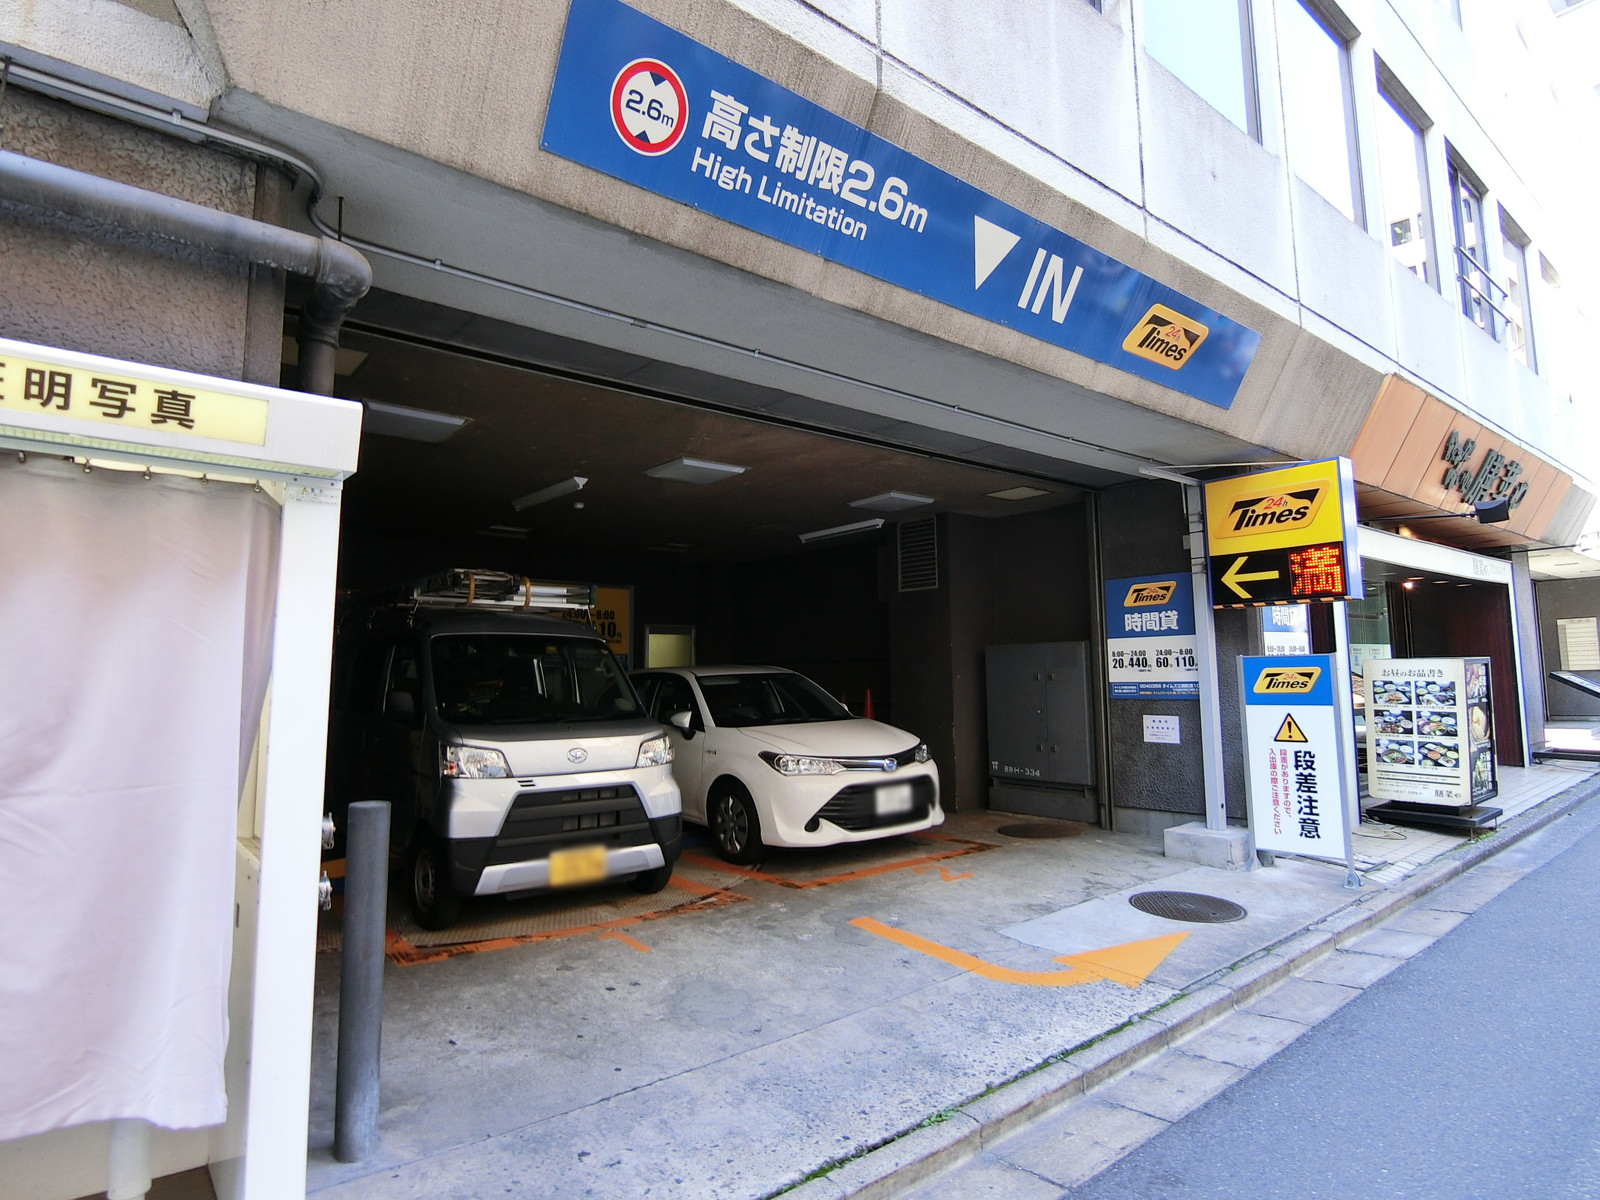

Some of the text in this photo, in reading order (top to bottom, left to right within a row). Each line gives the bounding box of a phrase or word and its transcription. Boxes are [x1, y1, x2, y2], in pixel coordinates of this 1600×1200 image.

[625, 89, 675, 128] 2.6m
[701, 89, 929, 233] 高さ制限2.6m
[691, 146, 868, 241] High Limitation
[1017, 247, 1084, 324] IN
[1137, 318, 1188, 361] Times
[1229, 499, 1311, 531] Times
[1263, 496, 1288, 510] 24h
[1290, 547, 1342, 595] 満
[1131, 588, 1167, 604] Times
[1124, 610, 1179, 632] 時間貸
[1263, 674, 1309, 690] Times
[1293, 750, 1321, 839] 段差注意
